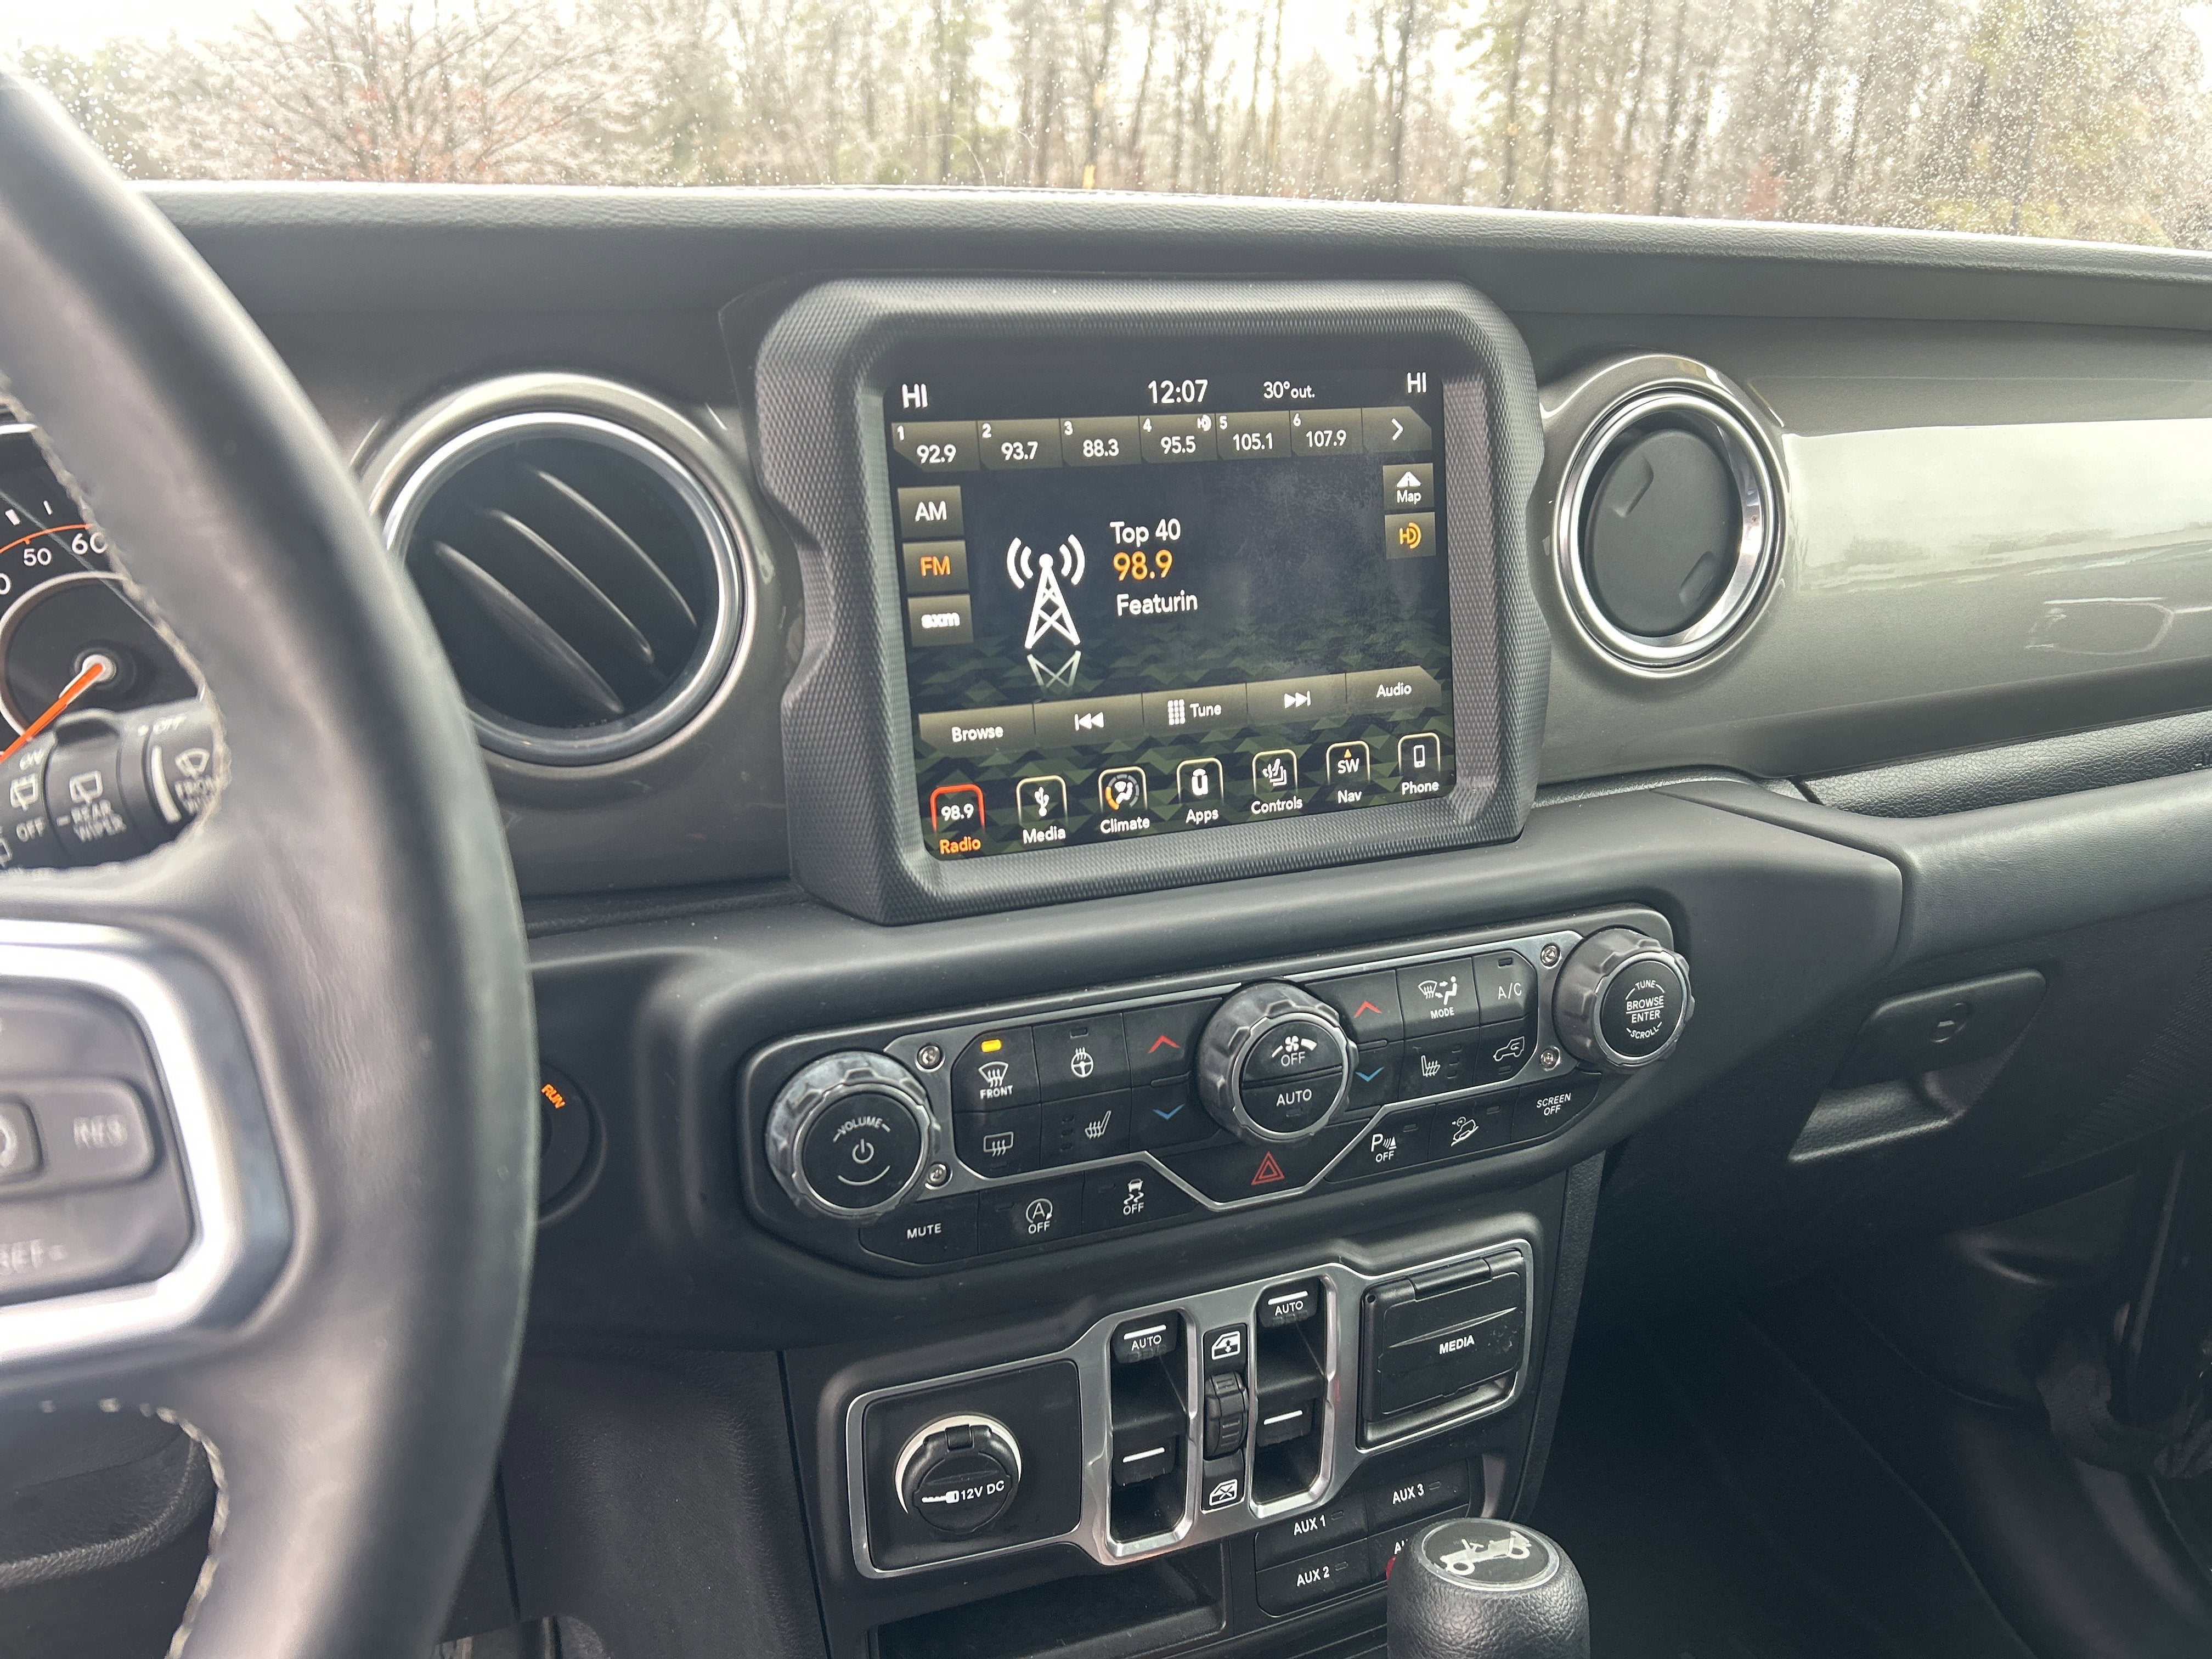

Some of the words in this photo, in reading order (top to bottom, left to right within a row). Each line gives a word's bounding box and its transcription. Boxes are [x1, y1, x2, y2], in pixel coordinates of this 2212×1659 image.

[1148, 379, 1208, 404] 12:07
[1407, 372, 1426, 393] HI
[902, 383, 928, 409] HI
[1064, 420, 1073, 436] 3
[1143, 418, 1152, 432] 4
[1219, 415, 1228, 430] 5
[1293, 413, 1301, 427] 6
[897, 425, 905, 441] 1
[982, 423, 992, 438] 2
[1306, 429, 1346, 448] 107.9
[1083, 438, 1119, 458] 88.3
[1160, 435, 1196, 454] 95.5
[1233, 432, 1273, 451] 105.1
[916, 444, 957, 464] 92.9
[1001, 441, 1039, 461] 93.7
[1397, 489, 1421, 505] Map
[915, 500, 947, 522] AM
[1109, 521, 1149, 548] Top
[1155, 518, 1181, 541] 40
[72, 533, 109, 555] 60
[24, 548, 52, 566] 50
[920, 555, 951, 576] FM
[1113, 549, 1173, 582] 98.9
[1116, 589, 1198, 616] Featurin
[1376, 681, 1412, 698] Audio
[1189, 703, 1222, 718] Tune
[951, 726, 1004, 743] Browse
[1337, 758, 1359, 774] SW
[1338, 789, 1362, 804] Nav
[1401, 781, 1440, 795] Phone
[941, 803, 974, 821] 98.9
[1251, 795, 1303, 815] Controls
[1100, 816, 1150, 834] Climate
[1186, 809, 1219, 825] Apps
[1023, 825, 1066, 844] Media
[939, 836, 981, 855] Radio
[1498, 982, 1522, 1000] A/C
[1635, 979, 1656, 990] TUNE
[1627, 995, 1664, 1011] BROWSE
[1430, 1007, 1455, 1019] MODE
[1631, 1009, 1661, 1024] ENTER
[1630, 1026, 1659, 1039] SCROLL
[1280, 1051, 1305, 1067] OFF
[541, 1084, 566, 1109] RUN
[979, 1085, 1013, 1099] FRONT
[1276, 1088, 1312, 1107] AUTO
[1536, 1092, 1571, 1108] SCREEN
[1543, 1104, 1561, 1116] OFF
[837, 1116, 882, 1135] VOLUME
[1375, 1150, 1395, 1163] OFF
[1123, 1202, 1144, 1215] OFF
[907, 1223, 941, 1239] MUTE
[1028, 1221, 1050, 1234] OFF
[1274, 1300, 1303, 1316] AUTO
[1131, 1334, 1161, 1351] AUTO
[1439, 1335, 1475, 1355] MEDIA
[961, 1486, 983, 1500] 12V
[986, 1480, 1005, 1495] DC
[1392, 1486, 1416, 1504] AUX
[1417, 1483, 1424, 1497] 3
[1294, 1517, 1318, 1536] AUX
[1319, 1515, 1326, 1527] 1
[1297, 1568, 1321, 1587] AUX
[1322, 1566, 1330, 1578] 2
